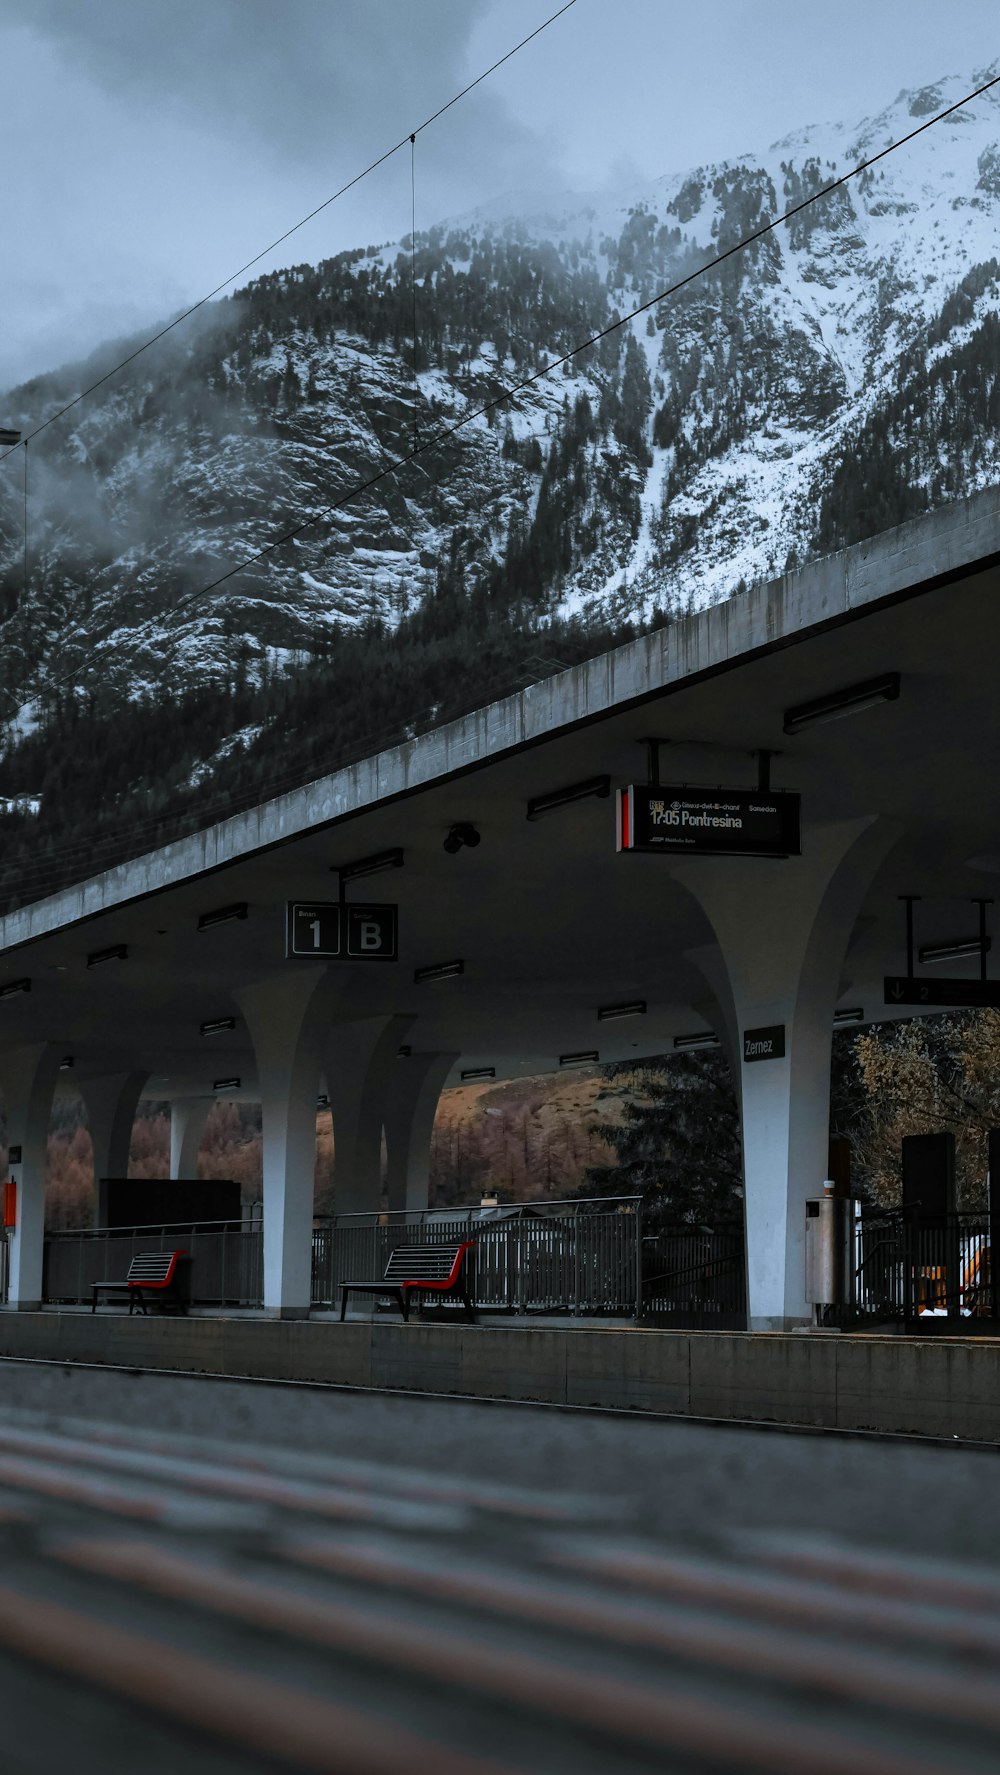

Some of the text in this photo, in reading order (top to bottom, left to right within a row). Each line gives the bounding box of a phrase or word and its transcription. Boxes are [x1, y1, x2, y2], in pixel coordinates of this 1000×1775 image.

[650, 810, 743, 828] 17:05 Pontresina
[309, 919, 321, 948] 1
[360, 921, 383, 950] B
[919, 985, 930, 1001] 2
[745, 1039, 773, 1056] Zernez
